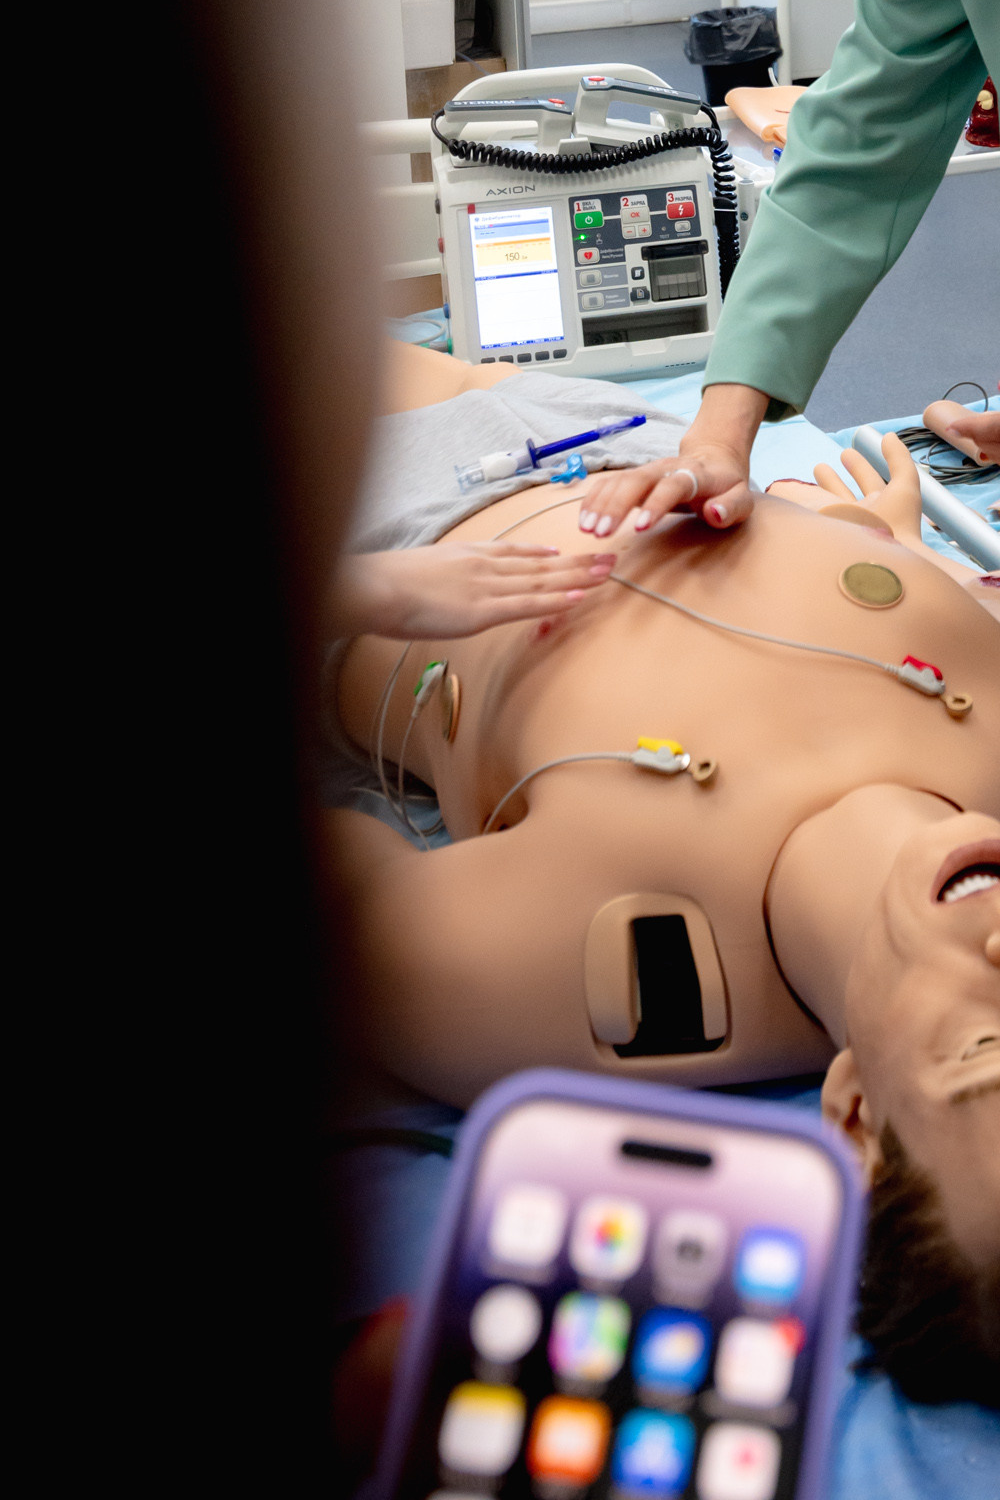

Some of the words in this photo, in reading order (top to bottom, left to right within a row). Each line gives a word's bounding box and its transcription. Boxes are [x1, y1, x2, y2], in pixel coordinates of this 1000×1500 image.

[648, 85, 679, 95] APEX
[486, 184, 536, 197] AXION
[622, 197, 629, 207] 2
[668, 192, 674, 202] 3
[575, 202, 582, 211] 1
[505, 252, 520, 262] 150
